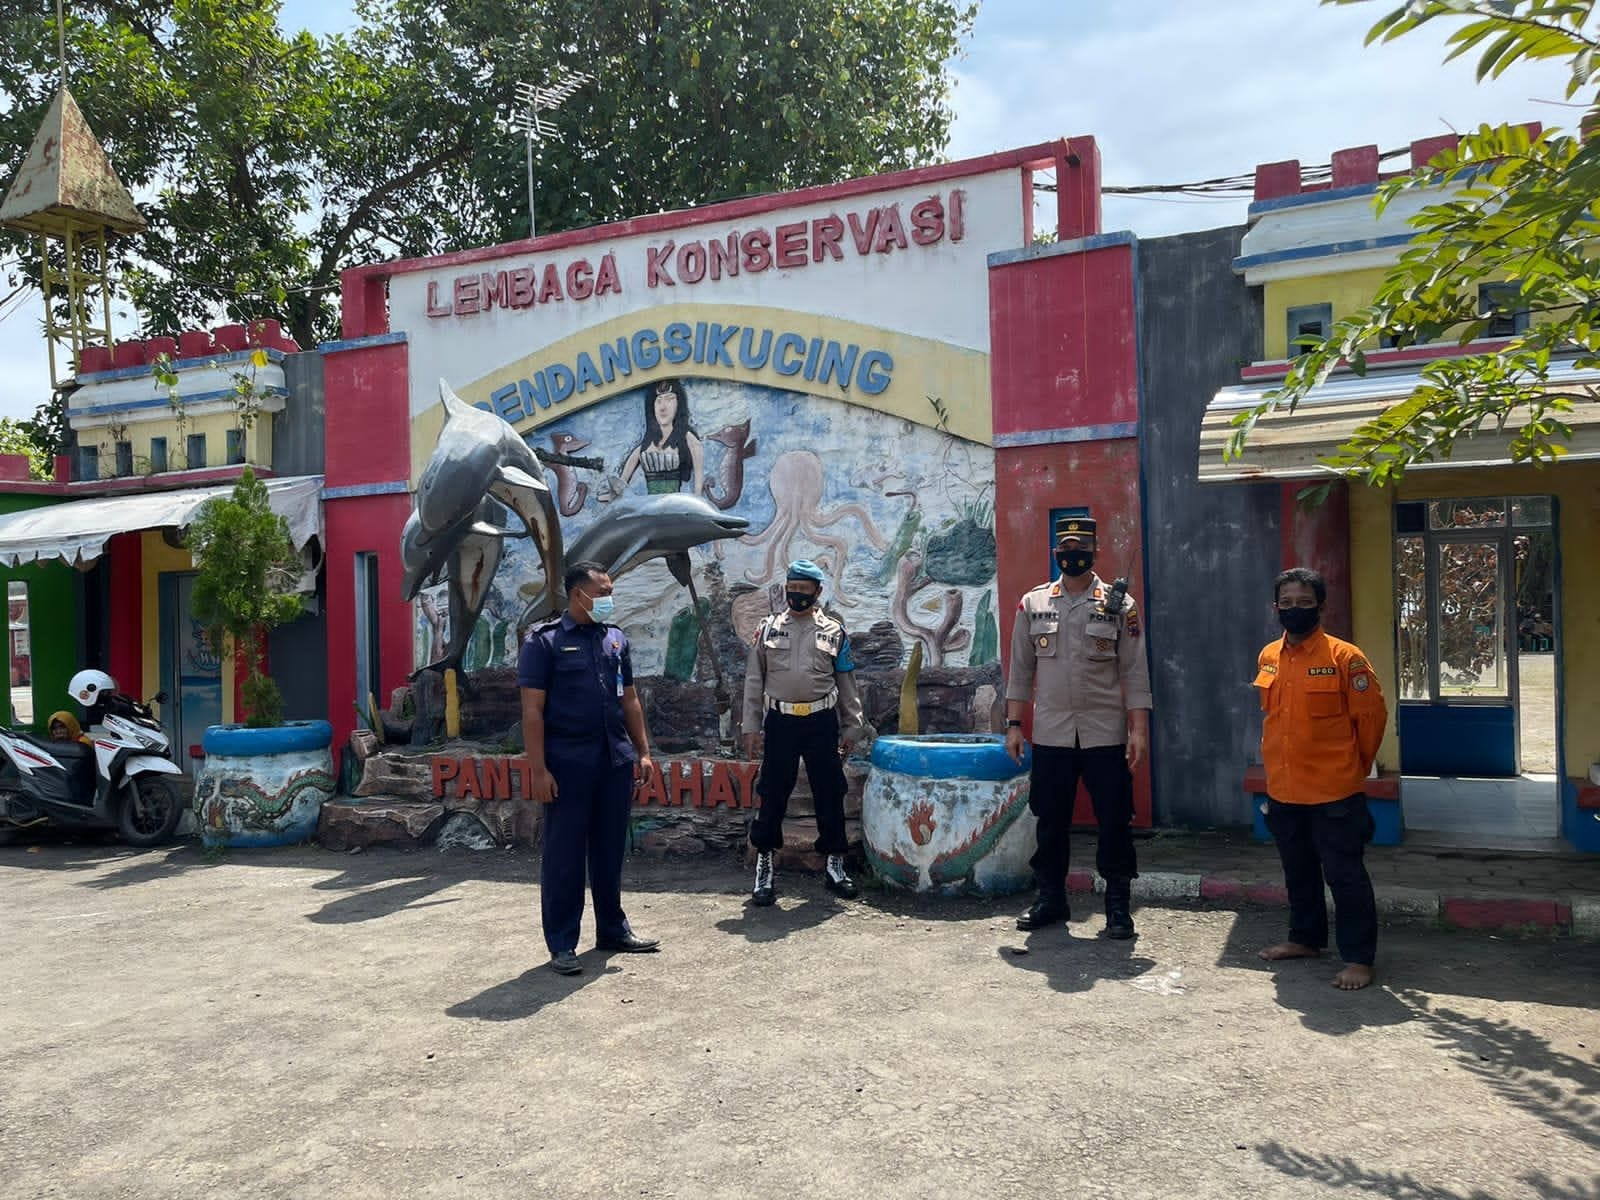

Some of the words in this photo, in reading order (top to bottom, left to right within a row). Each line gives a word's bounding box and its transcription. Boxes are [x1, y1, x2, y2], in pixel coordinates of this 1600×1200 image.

[426, 249, 622, 318] LEMBAGA
[646, 189, 967, 289] KONSERVASI
[633, 760, 762, 809] AHAY
